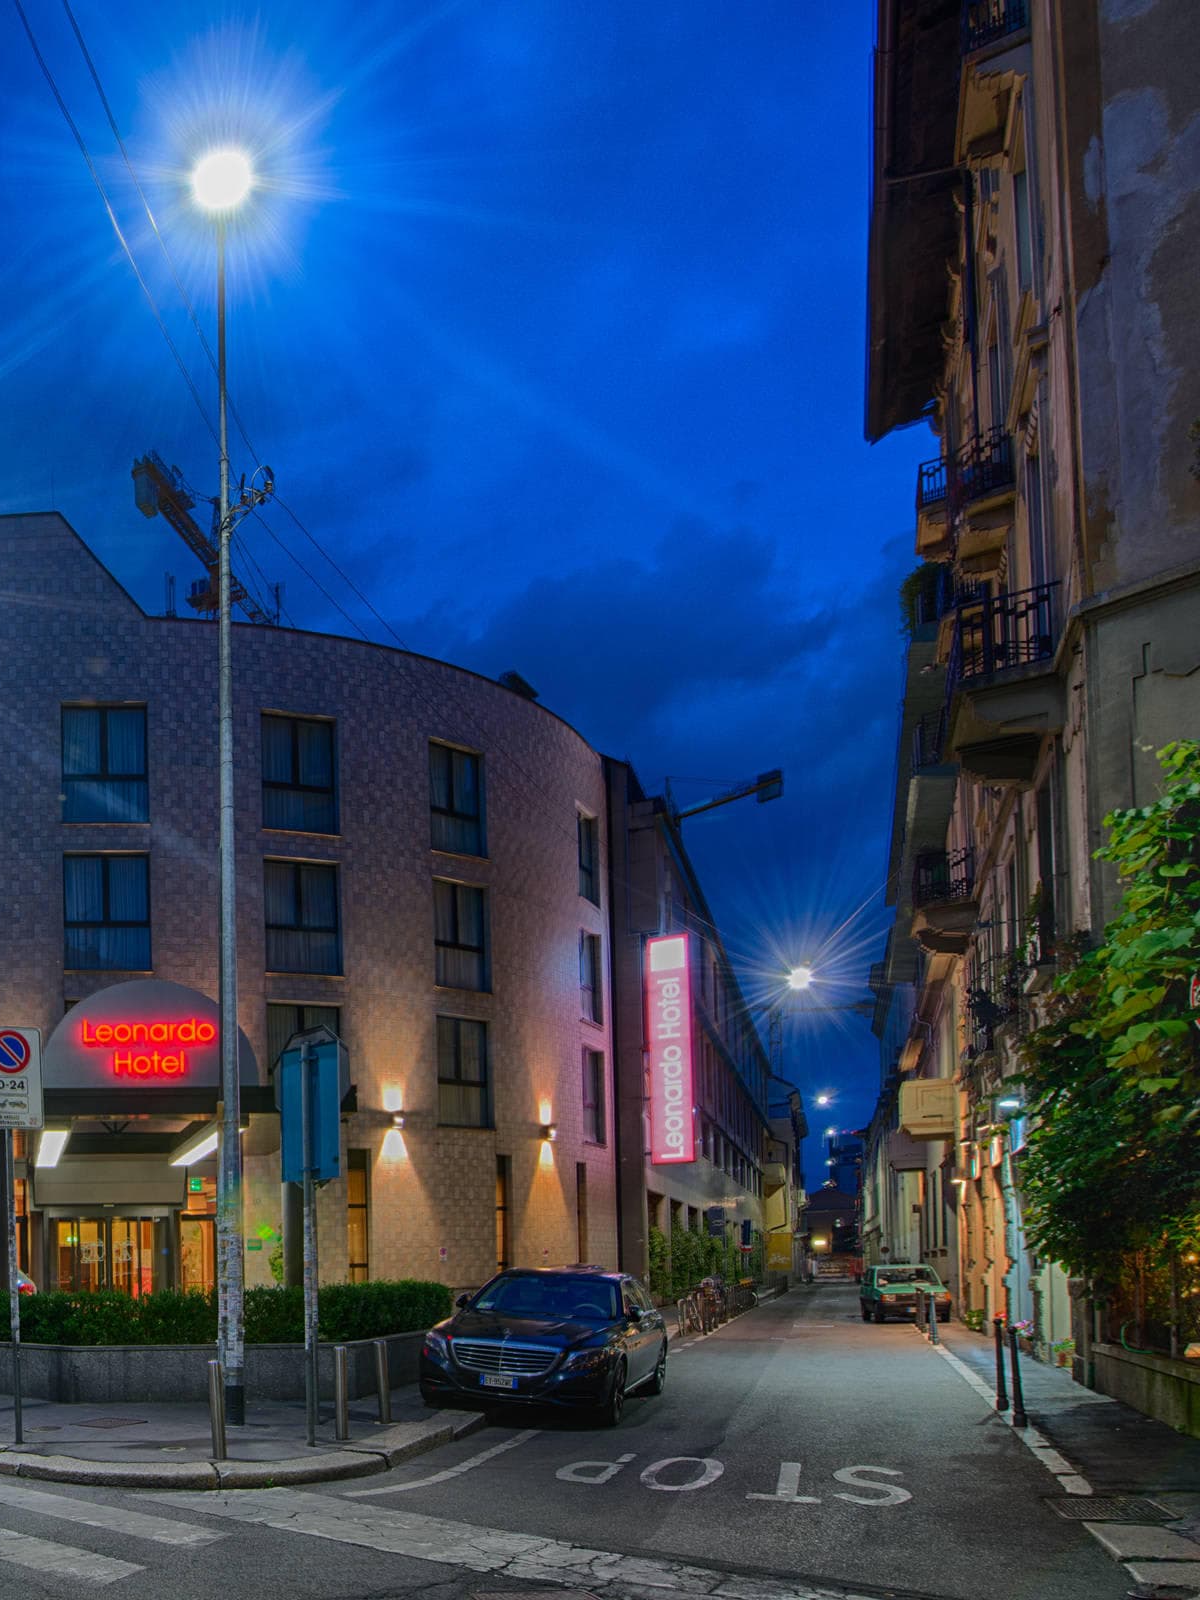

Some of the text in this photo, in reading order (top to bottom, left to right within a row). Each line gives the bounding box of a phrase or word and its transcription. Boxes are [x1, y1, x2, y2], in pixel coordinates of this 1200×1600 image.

[81, 1016, 216, 1044] Leonardo
[113, 1049, 186, 1075] Hotel
[656, 975, 685, 1160] Leonardo Hotel
[556, 1453, 912, 1506] STOP
